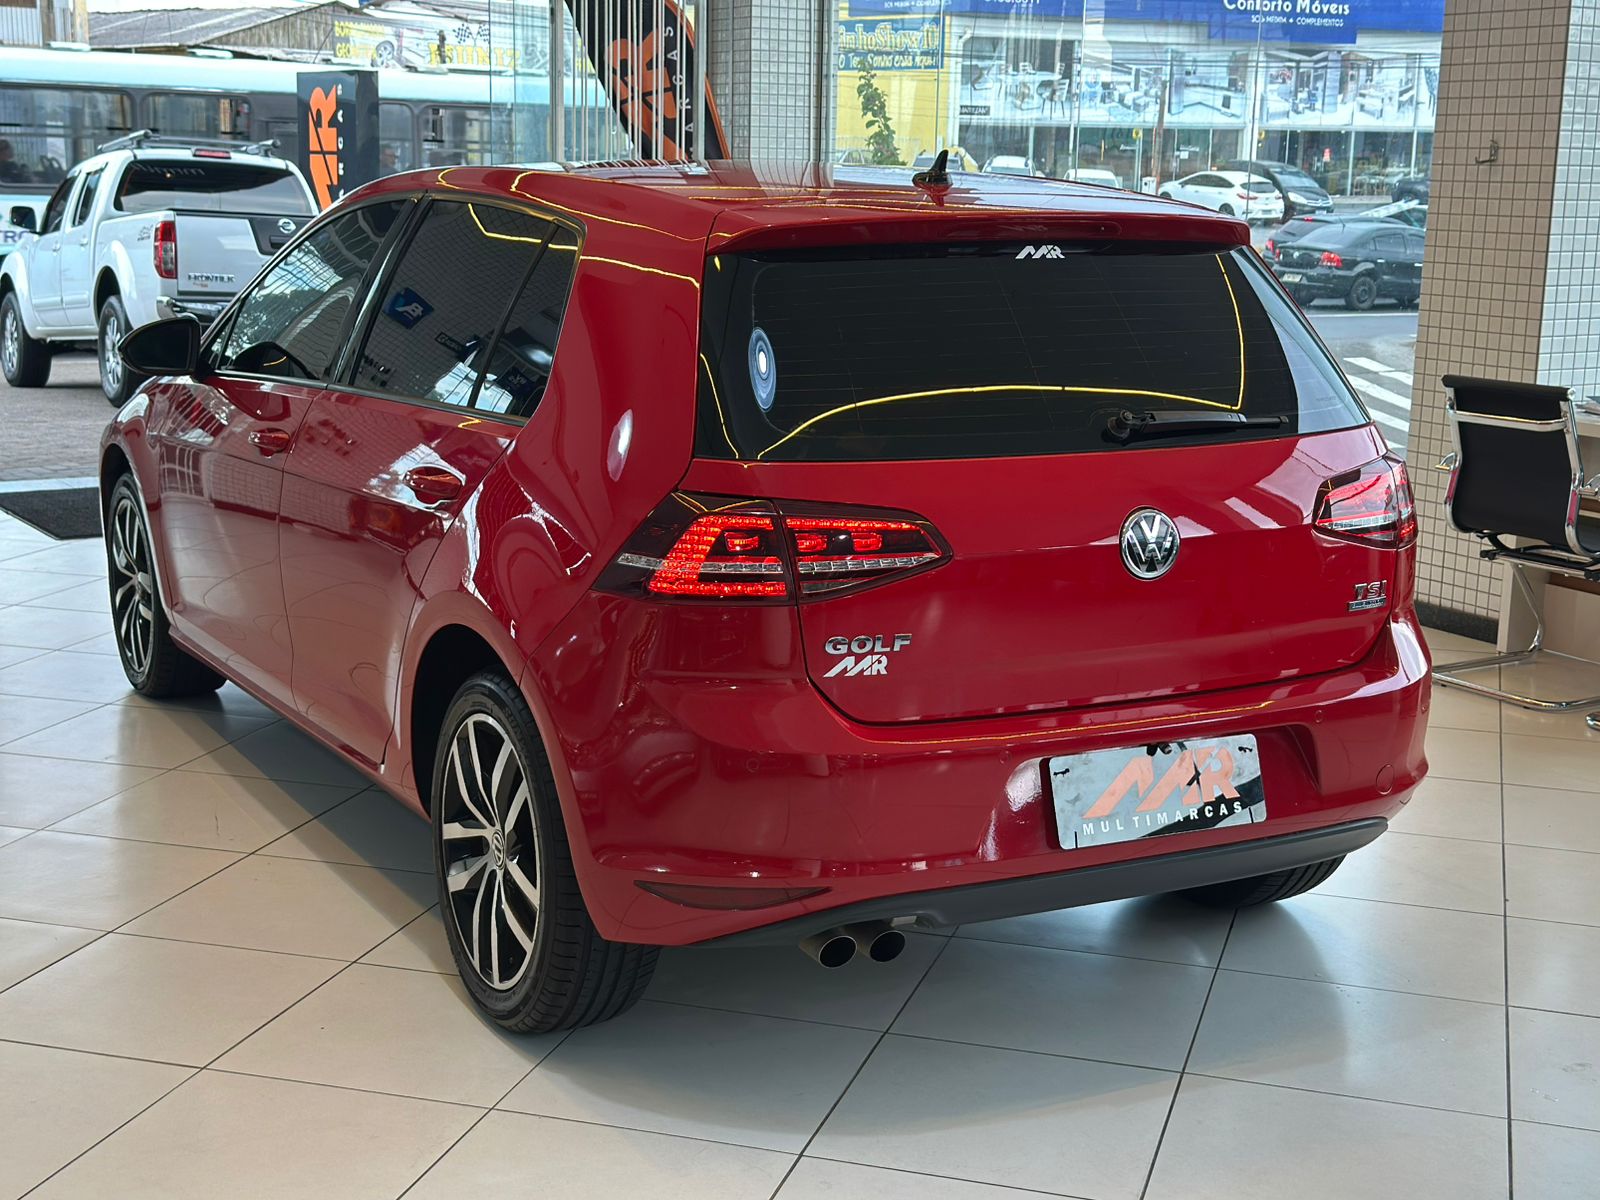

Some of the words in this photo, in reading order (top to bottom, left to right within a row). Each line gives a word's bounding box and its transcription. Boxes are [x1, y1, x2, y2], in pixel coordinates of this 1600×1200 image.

[1223, 0, 1293, 12] Conforto
[1296, 0, 1350, 15] Móveis
[1355, 580, 1387, 599] TSI
[825, 633, 912, 655] GOLF
[1083, 801, 1243, 836] MULTIMARCAS
